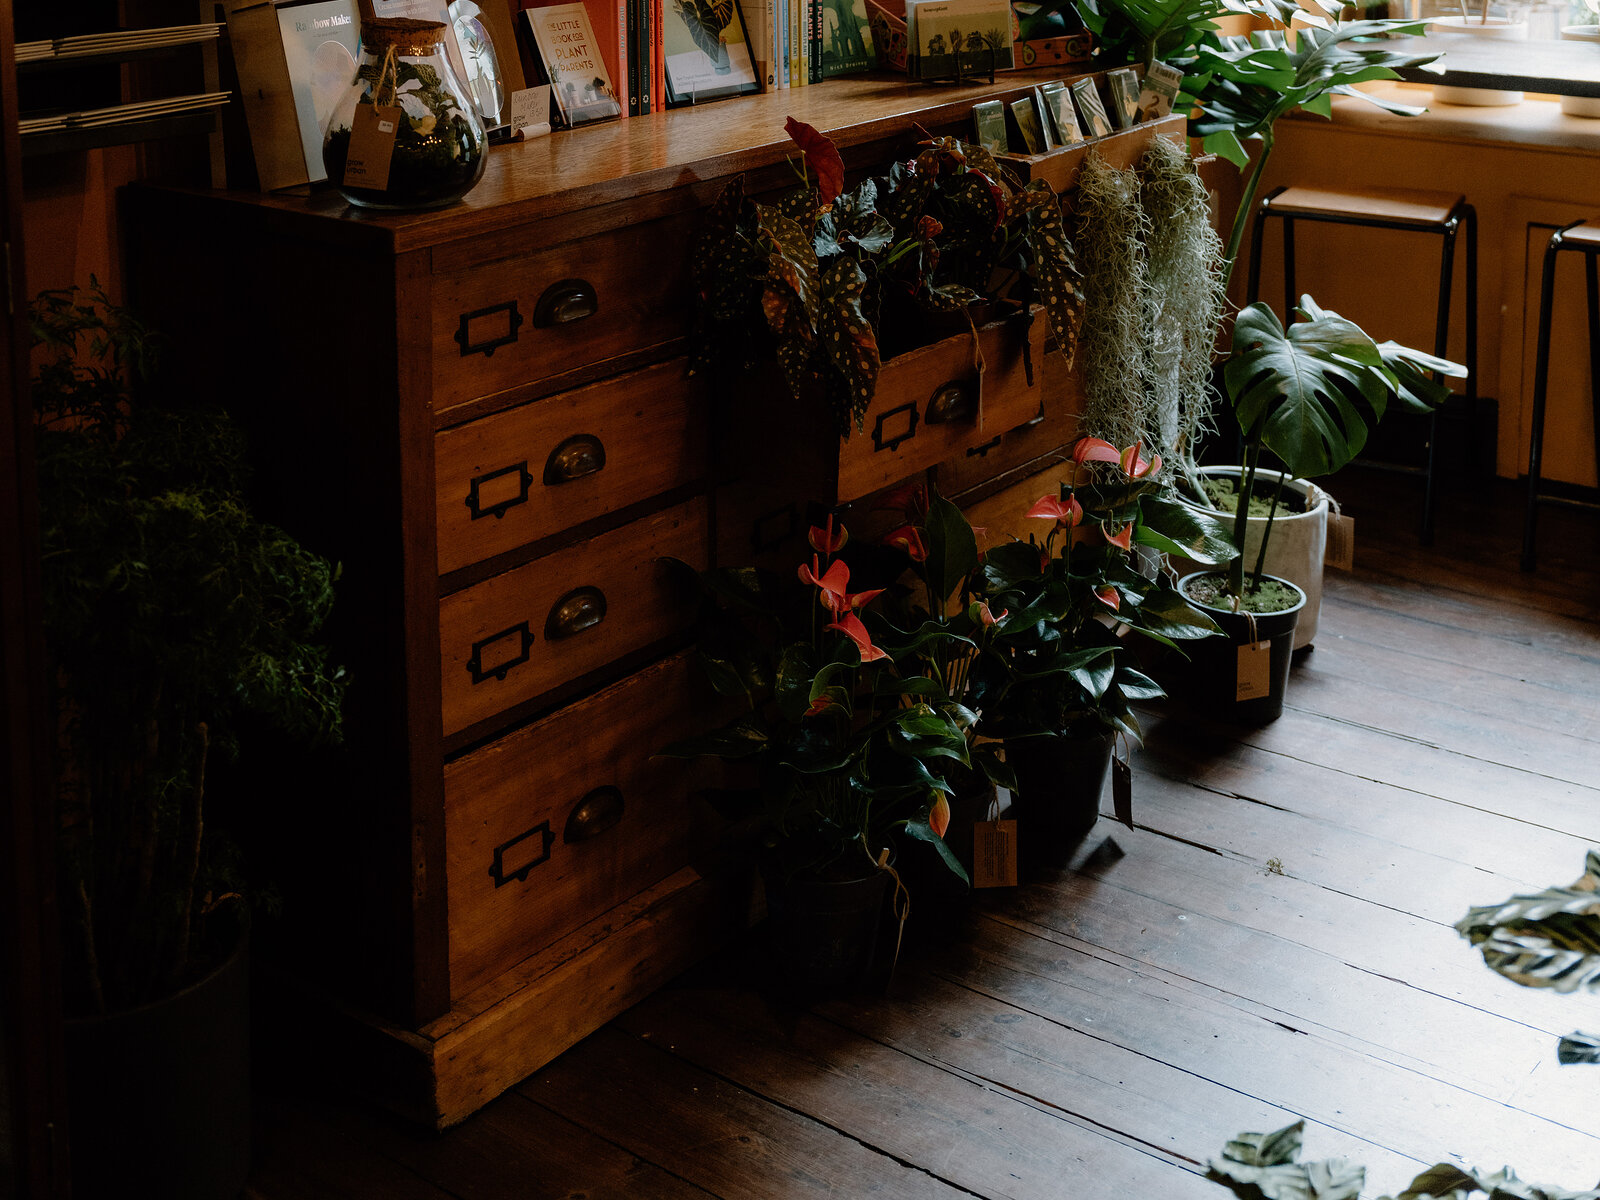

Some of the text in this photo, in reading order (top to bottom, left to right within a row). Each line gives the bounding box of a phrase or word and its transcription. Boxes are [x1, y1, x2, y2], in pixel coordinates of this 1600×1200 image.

[330, 13, 352, 28] Maker
[556, 20, 580, 31] LITTLE
[550, 33, 573, 45] BOOK
[555, 44, 588, 60] PLANT
[560, 60, 594, 72] PARENTS
[346, 159, 364, 168] grow
